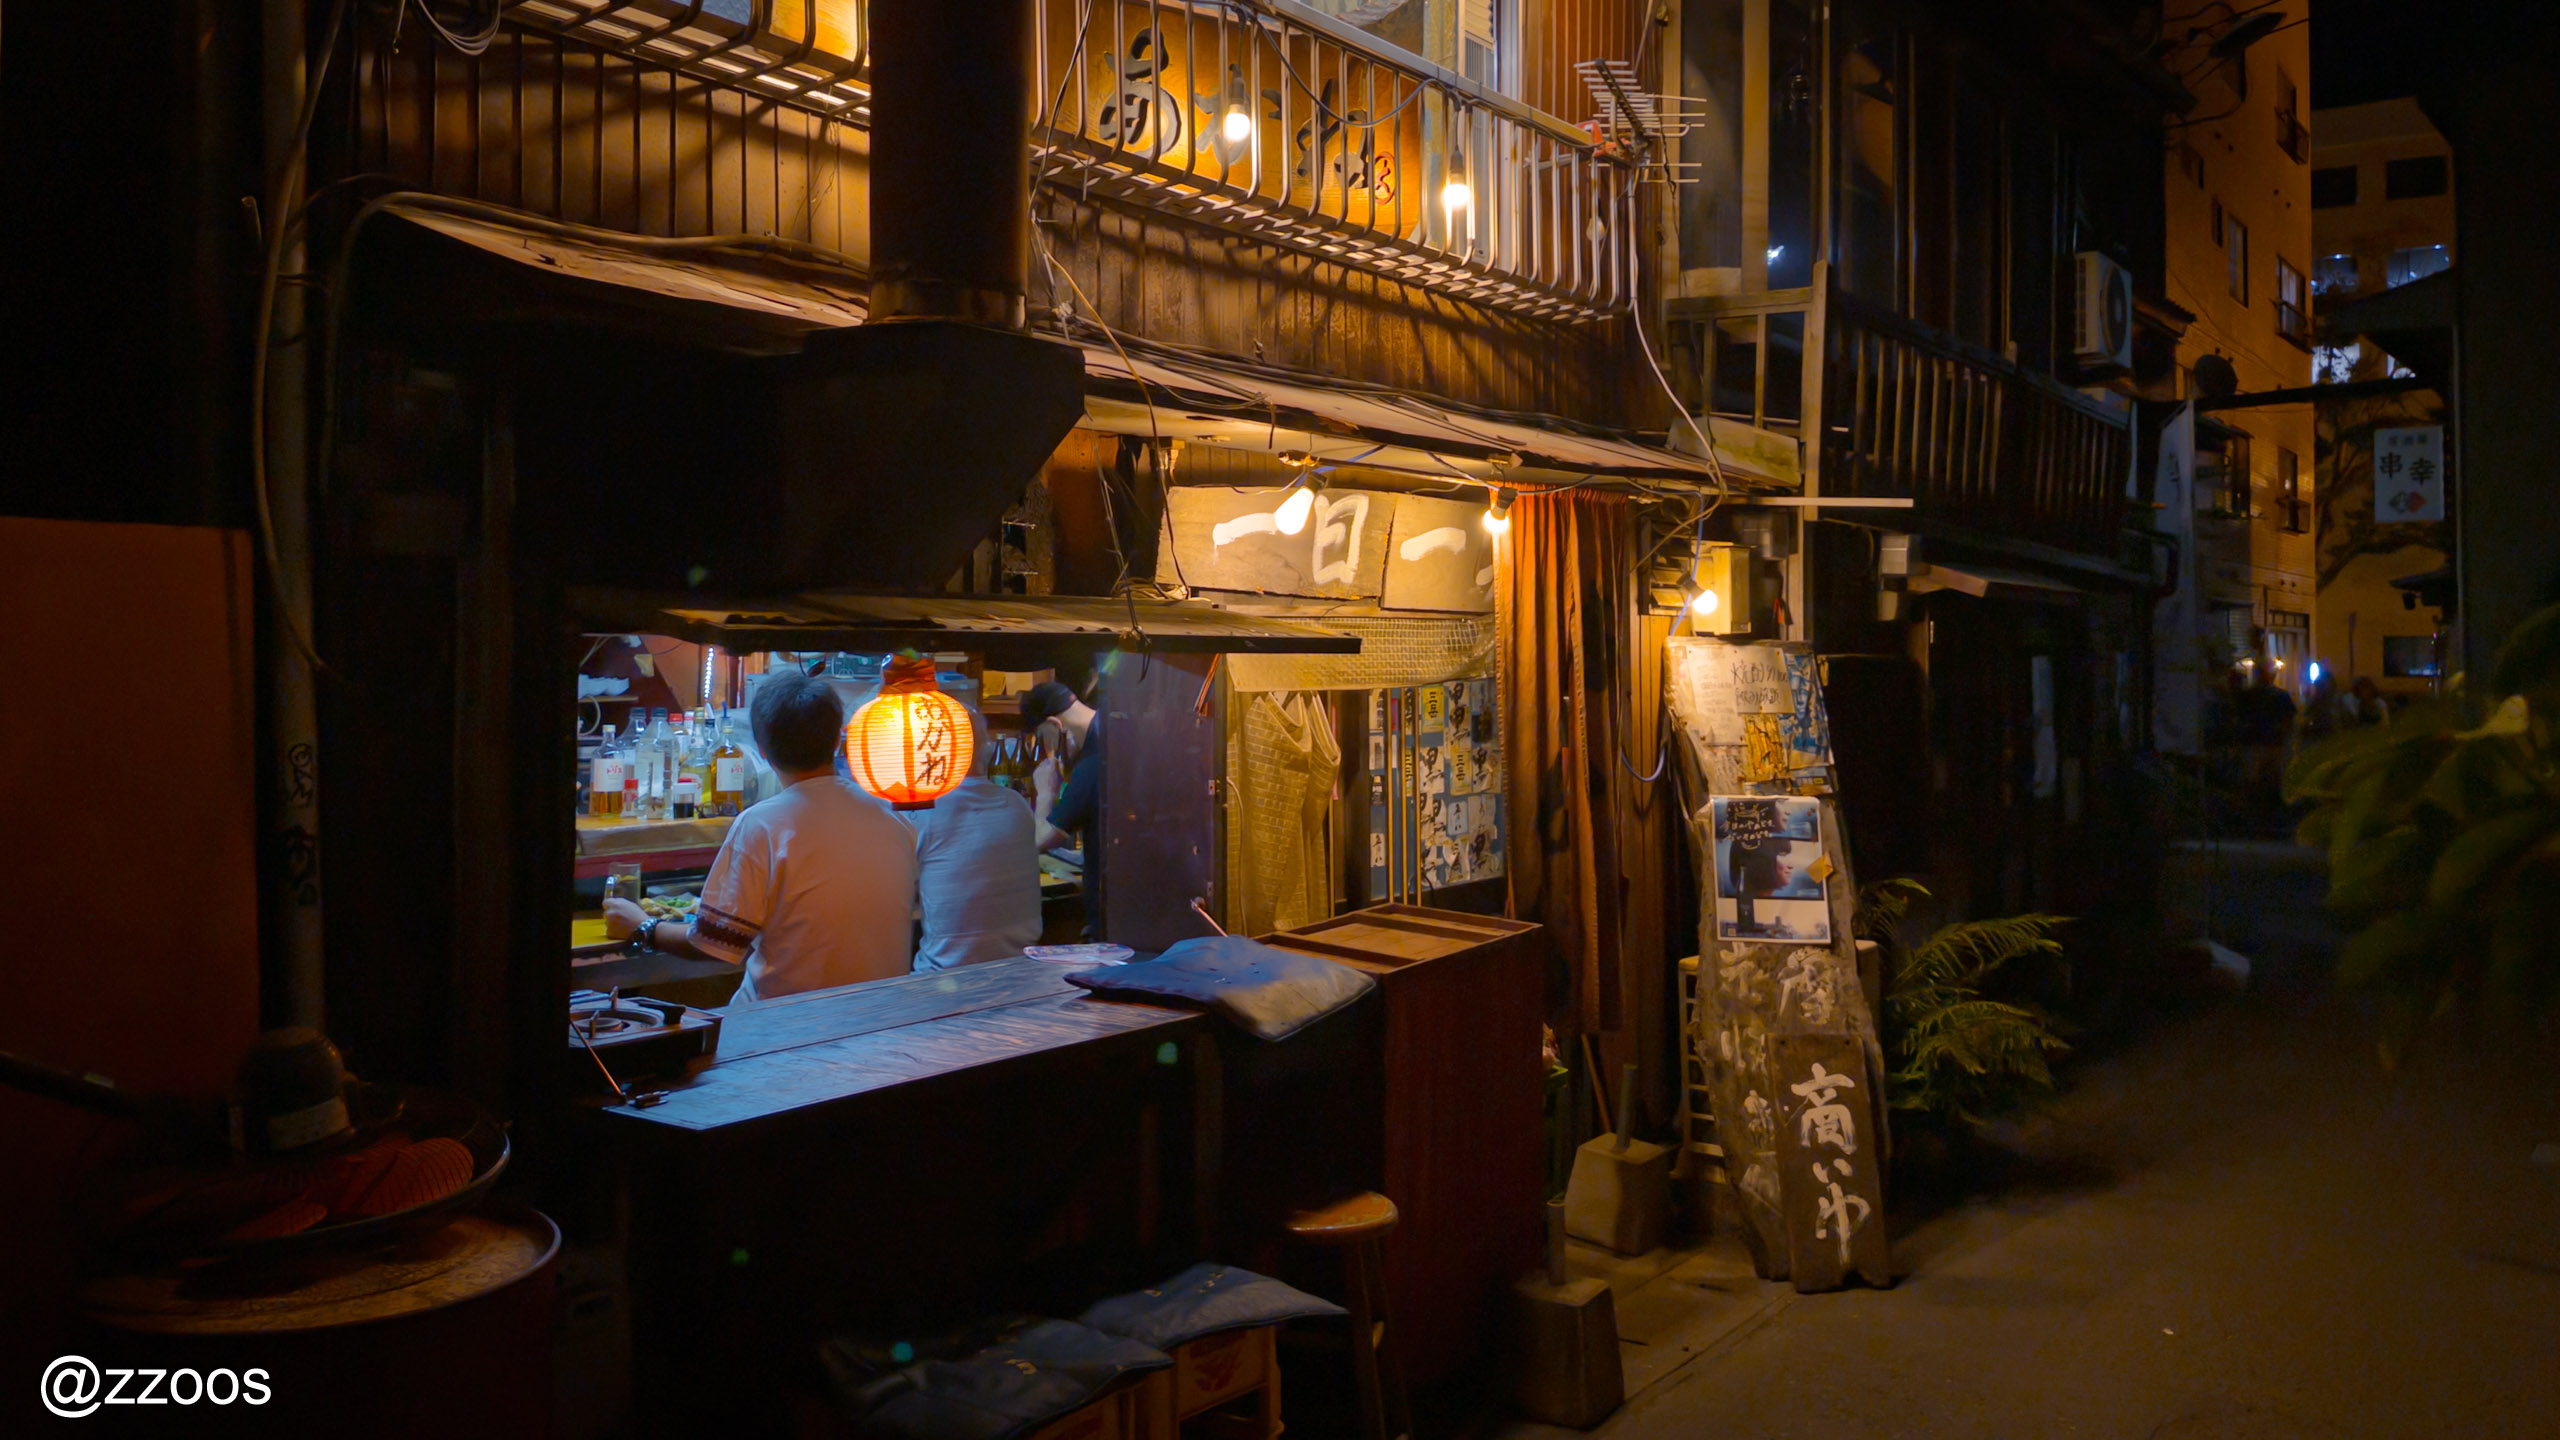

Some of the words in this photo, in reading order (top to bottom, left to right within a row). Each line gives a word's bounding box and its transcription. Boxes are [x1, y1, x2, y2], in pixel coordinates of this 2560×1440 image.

[2379, 451, 2436, 486] 串幸
[1790, 1062, 1872, 1266] 商い中
